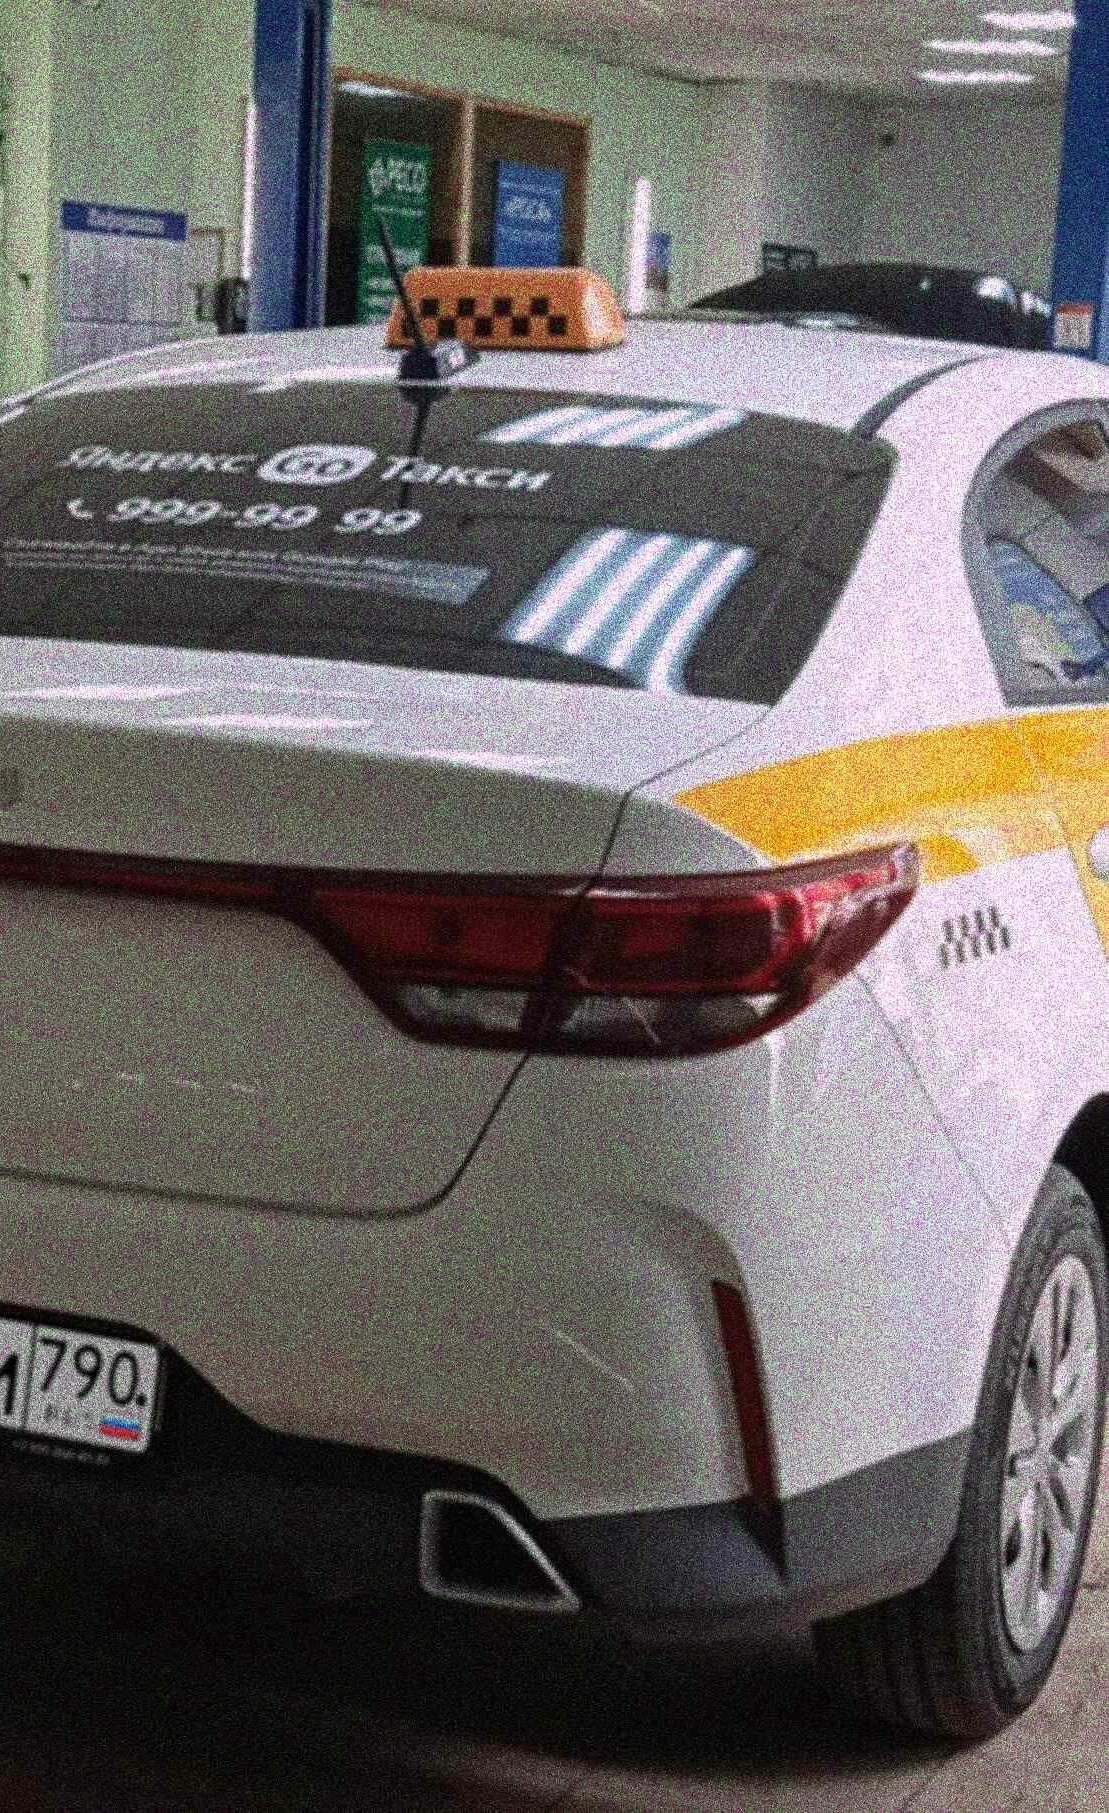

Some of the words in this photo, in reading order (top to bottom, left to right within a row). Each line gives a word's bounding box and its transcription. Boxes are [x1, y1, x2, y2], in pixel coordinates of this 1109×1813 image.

[56, 445, 258, 475] Яндекс
[380, 455, 552, 491] Такси
[40, 1337, 141, 1407] 790
